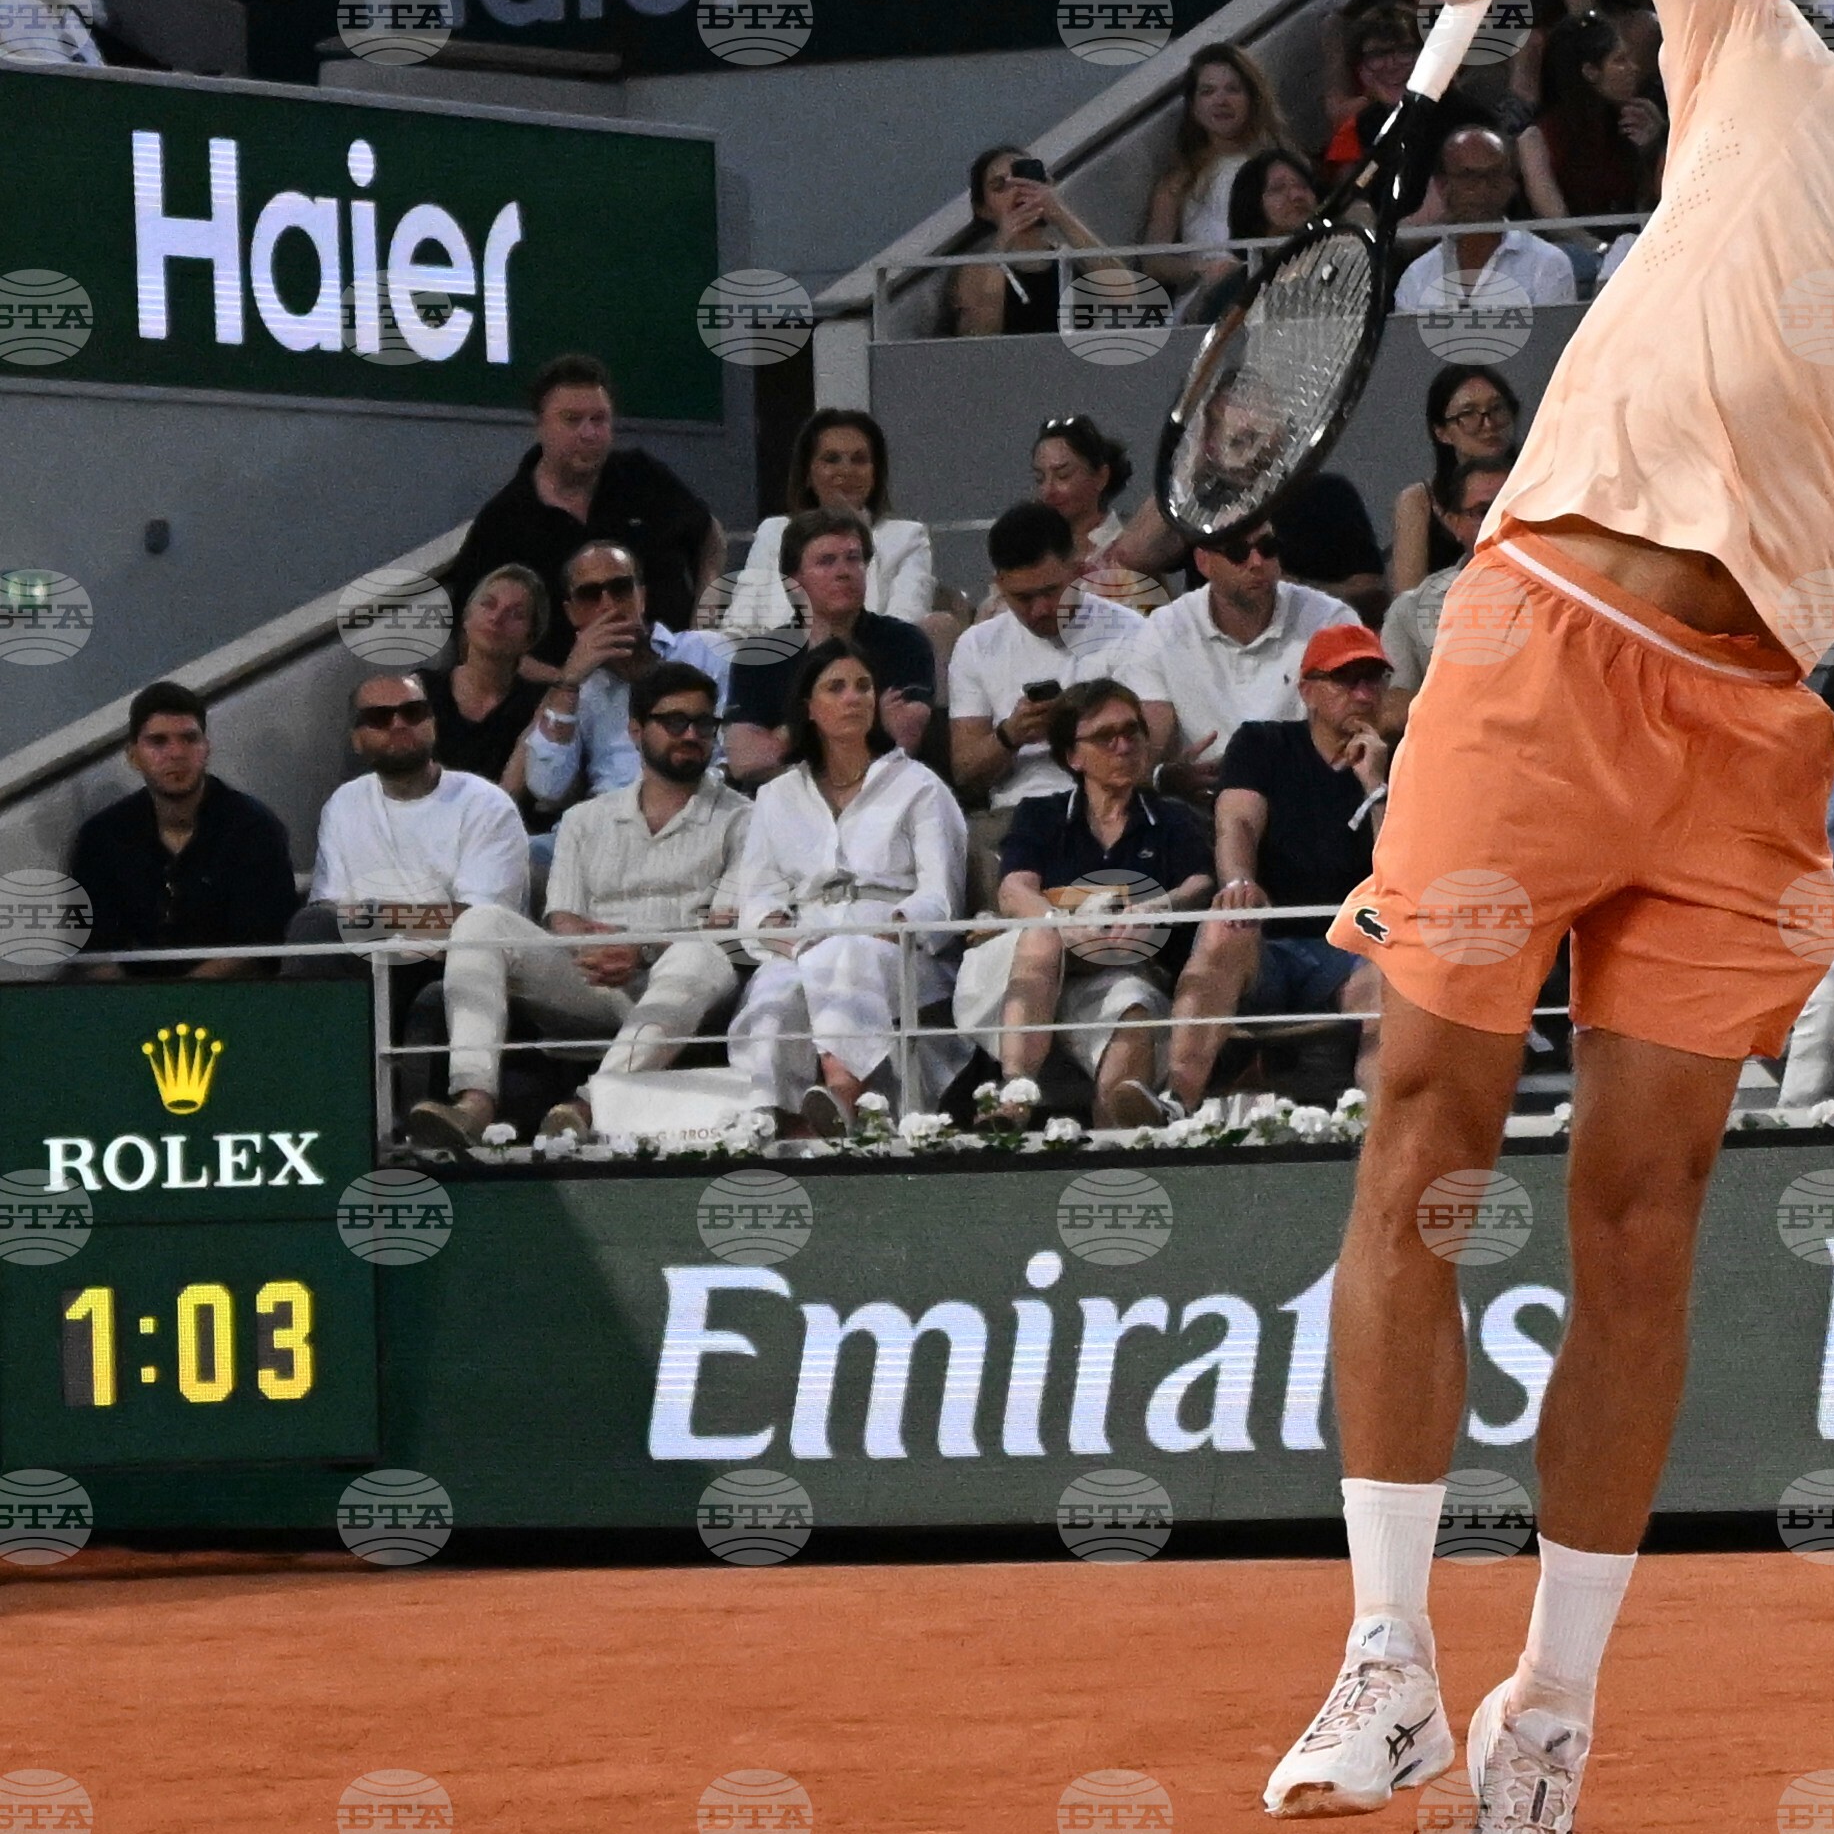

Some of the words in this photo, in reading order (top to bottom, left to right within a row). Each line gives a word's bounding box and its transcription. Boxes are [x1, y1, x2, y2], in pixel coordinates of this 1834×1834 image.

[131, 130, 523, 364] Haier
[43, 1130, 324, 1192] ROLEX
[63, 1280, 314, 1407] 1:03
[646, 1250, 1567, 1461] Emirats
